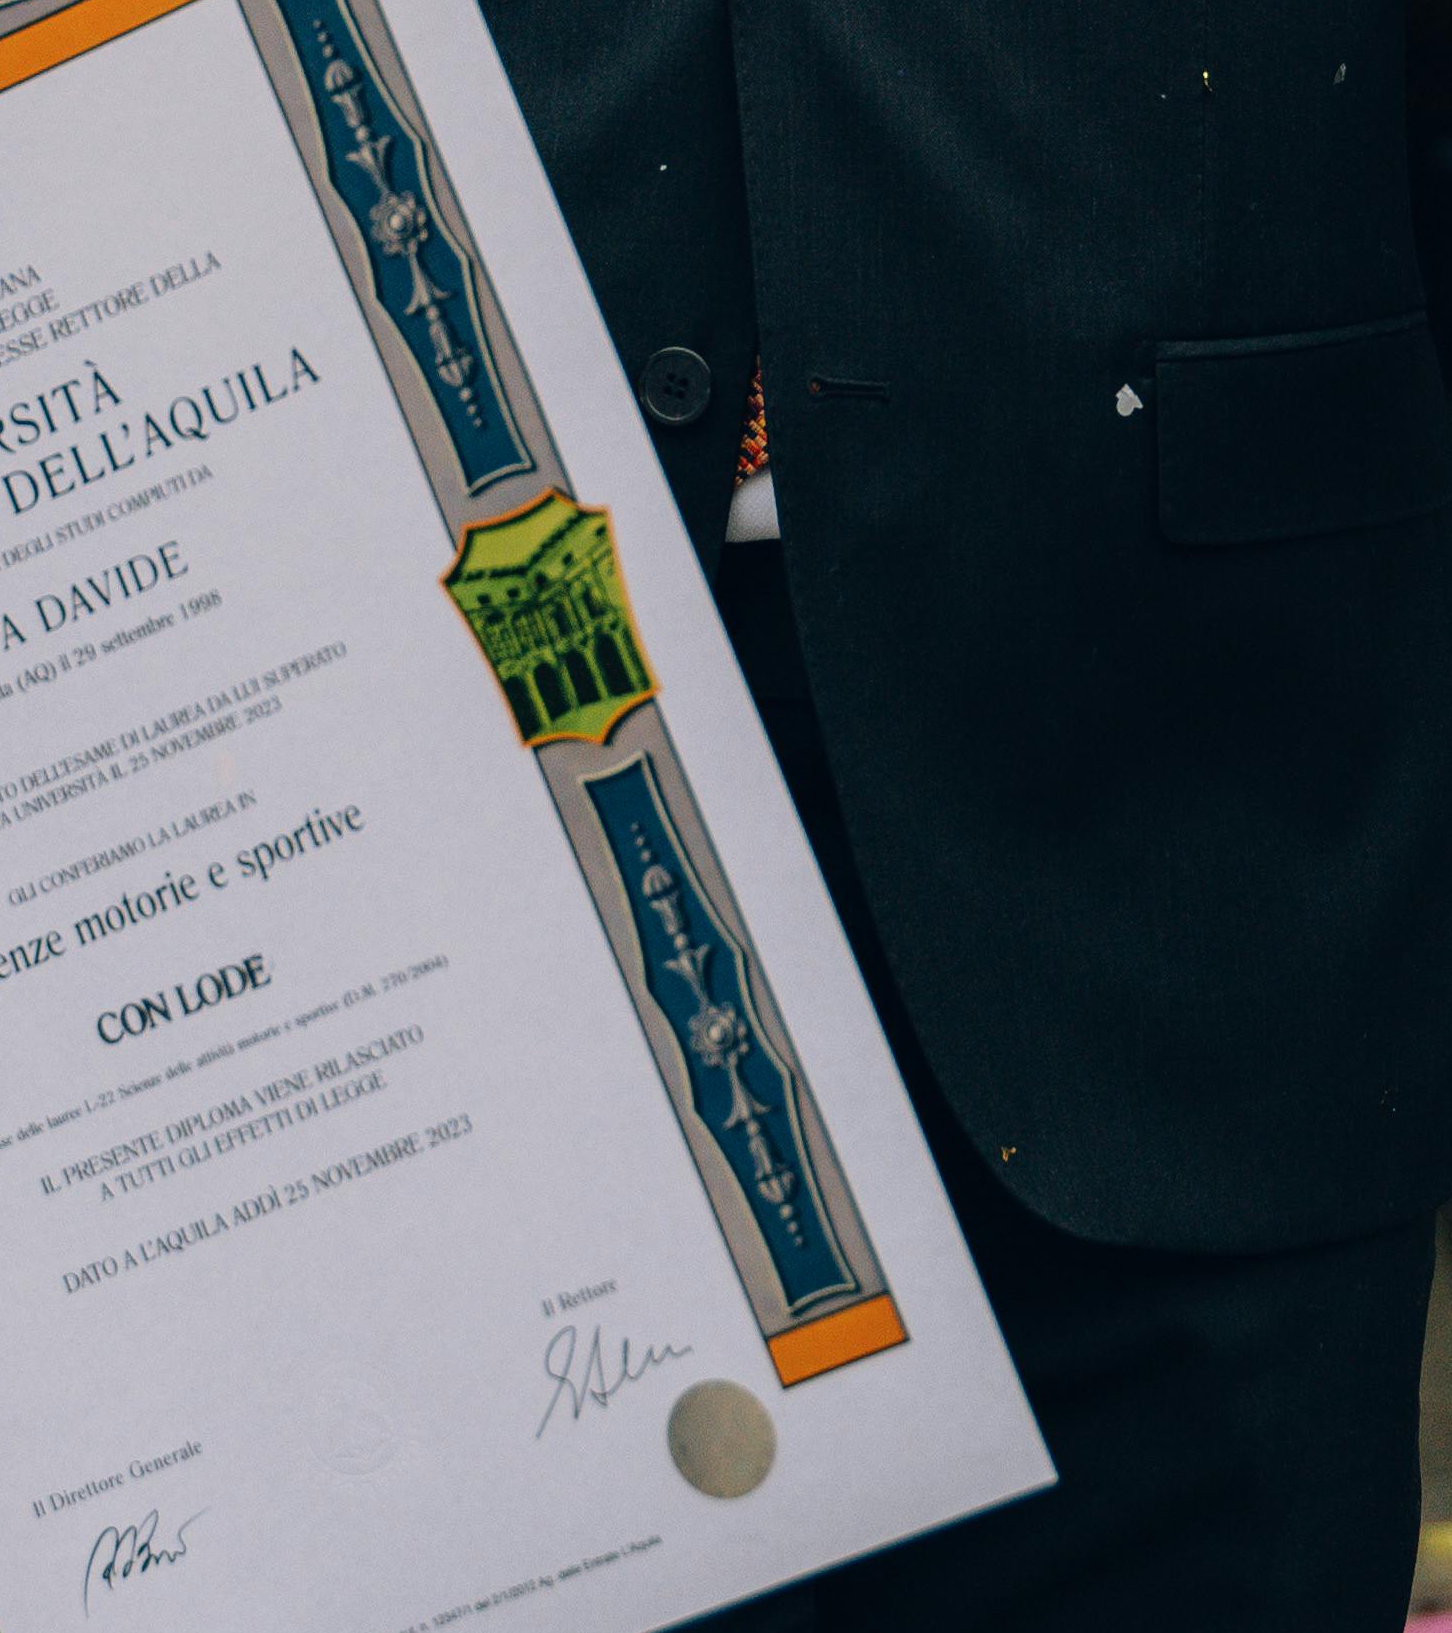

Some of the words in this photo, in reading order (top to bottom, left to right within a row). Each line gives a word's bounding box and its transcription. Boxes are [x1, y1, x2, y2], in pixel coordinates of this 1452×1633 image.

[47, 283, 149, 342] RETTORE
[148, 251, 221, 297] DELLA
[1, 347, 319, 515] DELL'AQUILA
[0, 532, 54, 568] DEGLI
[54, 509, 105, 544] STUDI
[106, 473, 187, 522] COMPIUTI
[186, 463, 213, 487] DA
[15, 661, 57, 693] (AQ)
[58, 653, 72, 673] il
[72, 643, 97, 667] 29
[99, 613, 174, 654] settembre
[178, 589, 222, 620] 1998
[34, 540, 188, 633] DAVIDE
[11, 769, 109, 821] UNIVERSITÀ
[108, 762, 128, 781] IL
[128, 752, 150, 773] 25
[149, 713, 237, 762] NOVEMBRE
[242, 694, 282, 725] 2023
[18, 739, 119, 793] DELL'ESAME
[118, 728, 141, 750] DI
[140, 701, 207, 742] LAUREA
[205, 691, 232, 714] DA
[231, 677, 261, 702] LUI
[261, 641, 347, 690] SUPERATO
[6, 881, 38, 905] GLI
[37, 836, 146, 894] CONFERIAMO
[146, 826, 171, 848] LA
[169, 798, 237, 838] LAUREA
[236, 790, 257, 810] IN
[73, 871, 198, 946] motorie
[206, 863, 227, 889] e
[236, 805, 363, 881] sportive
[95, 991, 172, 1045] CON
[174, 954, 271, 1016] LODE
[39, 1174, 62, 1196] IL
[61, 1132, 164, 1186] PRESENTE
[164, 1094, 253, 1144] DIPLOMA
[253, 1071, 307, 1106] VIENE
[313, 1024, 424, 1083] RILASCIATO
[100, 1181, 114, 1202] A
[114, 1155, 176, 1193] TUTTI
[177, 1140, 212, 1169] GLI
[212, 1107, 294, 1155] EFFETTI
[293, 1097, 319, 1122] DI
[318, 1070, 387, 1112] LEGGE
[61, 1256, 119, 1294] DATO
[123, 1249, 138, 1270] A
[138, 1212, 229, 1263] L'AQUILA
[232, 1184, 282, 1227] ADDÌ
[282, 1179, 309, 1206] 25
[310, 1134, 424, 1193] NOVEMBRE
[424, 1113, 473, 1148] 2023
[540, 1298, 555, 1319] Il
[556, 1278, 617, 1311] Rettore
[31, 1499, 46, 1519] Il
[47, 1473, 123, 1512] Direttore
[127, 1440, 202, 1479] Generale
